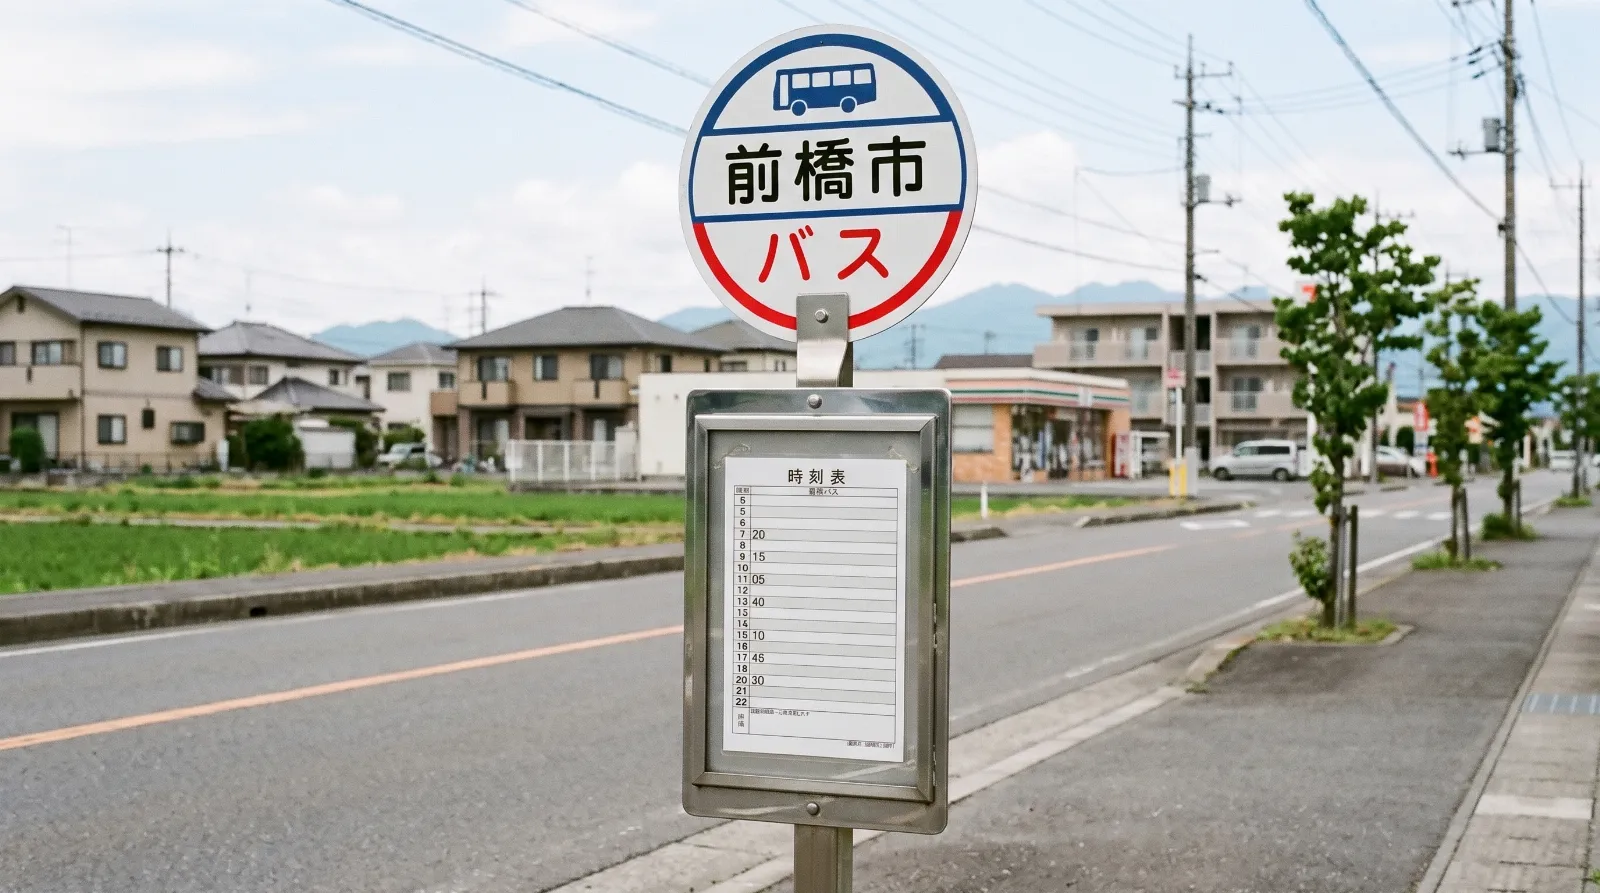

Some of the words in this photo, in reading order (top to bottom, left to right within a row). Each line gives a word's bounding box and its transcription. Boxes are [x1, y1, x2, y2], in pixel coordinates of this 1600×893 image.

[725, 135, 927, 206] 前橋市
[758, 224, 890, 284] バス
[788, 468, 846, 485] 時刻表
[740, 508, 746, 516] 5
[740, 518, 746, 526] 6
[740, 530, 746, 538] 7
[752, 530, 766, 540] 20
[740, 540, 746, 550] 8
[740, 552, 746, 560] 9
[754, 552, 766, 562] 15
[738, 564, 748, 572] 10
[752, 574, 766, 586] 05
[738, 586, 748, 594] 12
[738, 598, 748, 606] 13
[752, 598, 764, 606] 40
[738, 630, 748, 638] 15
[752, 630, 764, 642] 10
[738, 642, 748, 650] 16
[738, 654, 748, 662] 17
[752, 654, 764, 662] 45
[738, 664, 748, 672] 18
[736, 676, 748, 684] 20
[750, 676, 764, 686] 30
[736, 686, 746, 694] 21
[736, 698, 748, 706] 22
